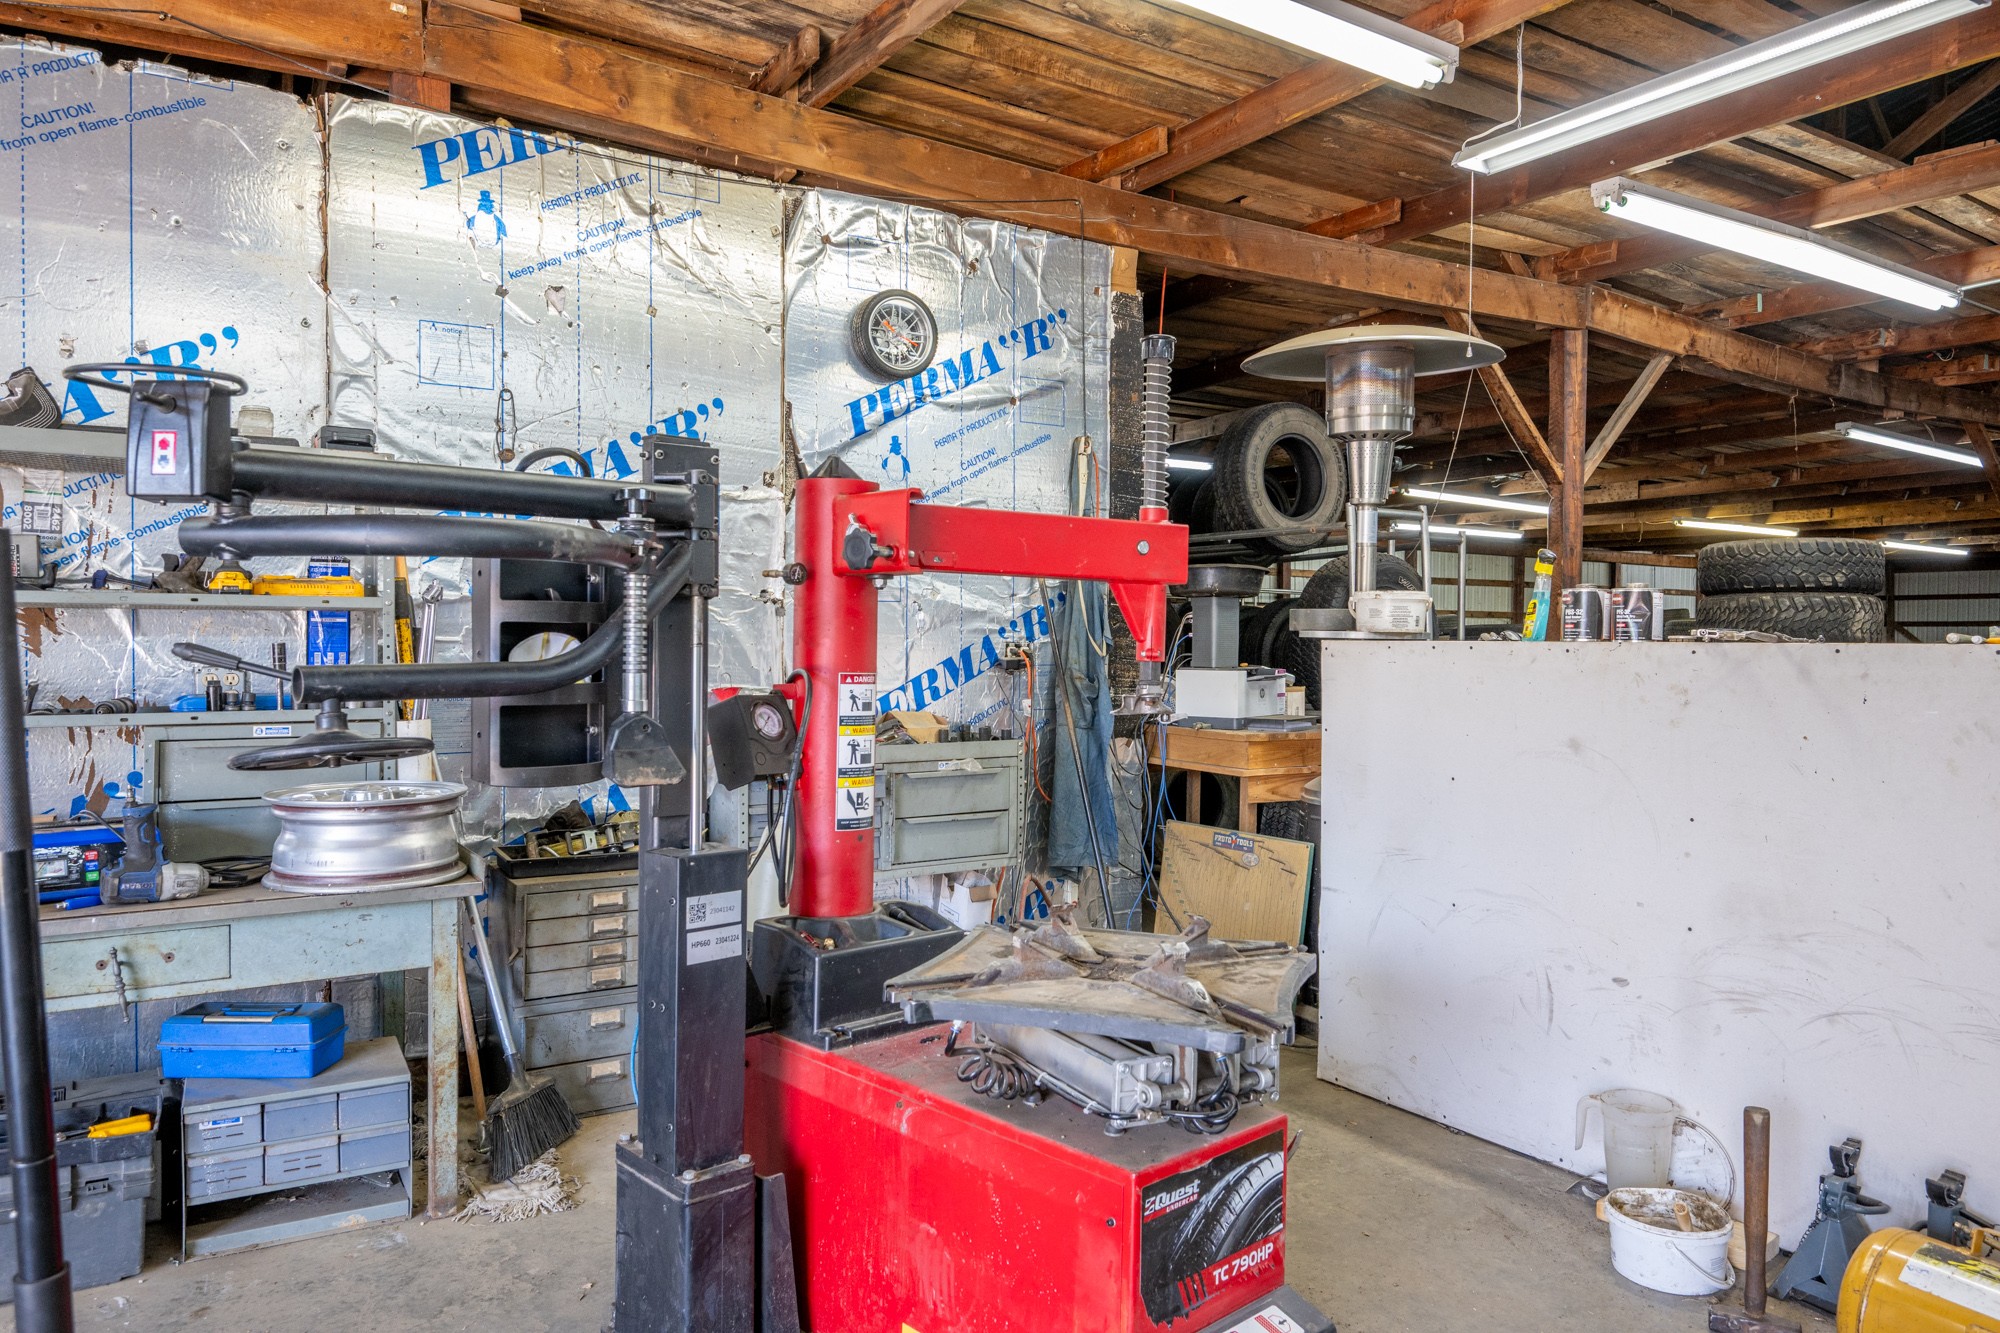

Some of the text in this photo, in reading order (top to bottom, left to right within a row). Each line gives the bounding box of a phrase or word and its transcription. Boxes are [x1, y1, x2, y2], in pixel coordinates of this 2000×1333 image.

[0, 96, 207, 152] from open flame-combustible
[21, 102, 96, 129] CAUTION!
[577, 217, 627, 242] CAUTION!
[508, 209, 702, 280] keep away from open flame-combustible
[931, 483, 951, 498] away
[950, 473, 969, 488] from
[969, 466, 989, 480] open
[989, 432, 1052, 470] flame-combustible
[960, 447, 998, 471] CAUTION!
[23, 505, 33, 530] 8002
[51, 507, 61, 532] 2462
[1214, 834, 1232, 844] PROTO
[1236, 838, 1253, 847] TOOLS
[691, 938, 711, 949] HP660
[1166, 1193, 1199, 1213] UNDERCAR
[1213, 1242, 1274, 1285] TC 790HP
